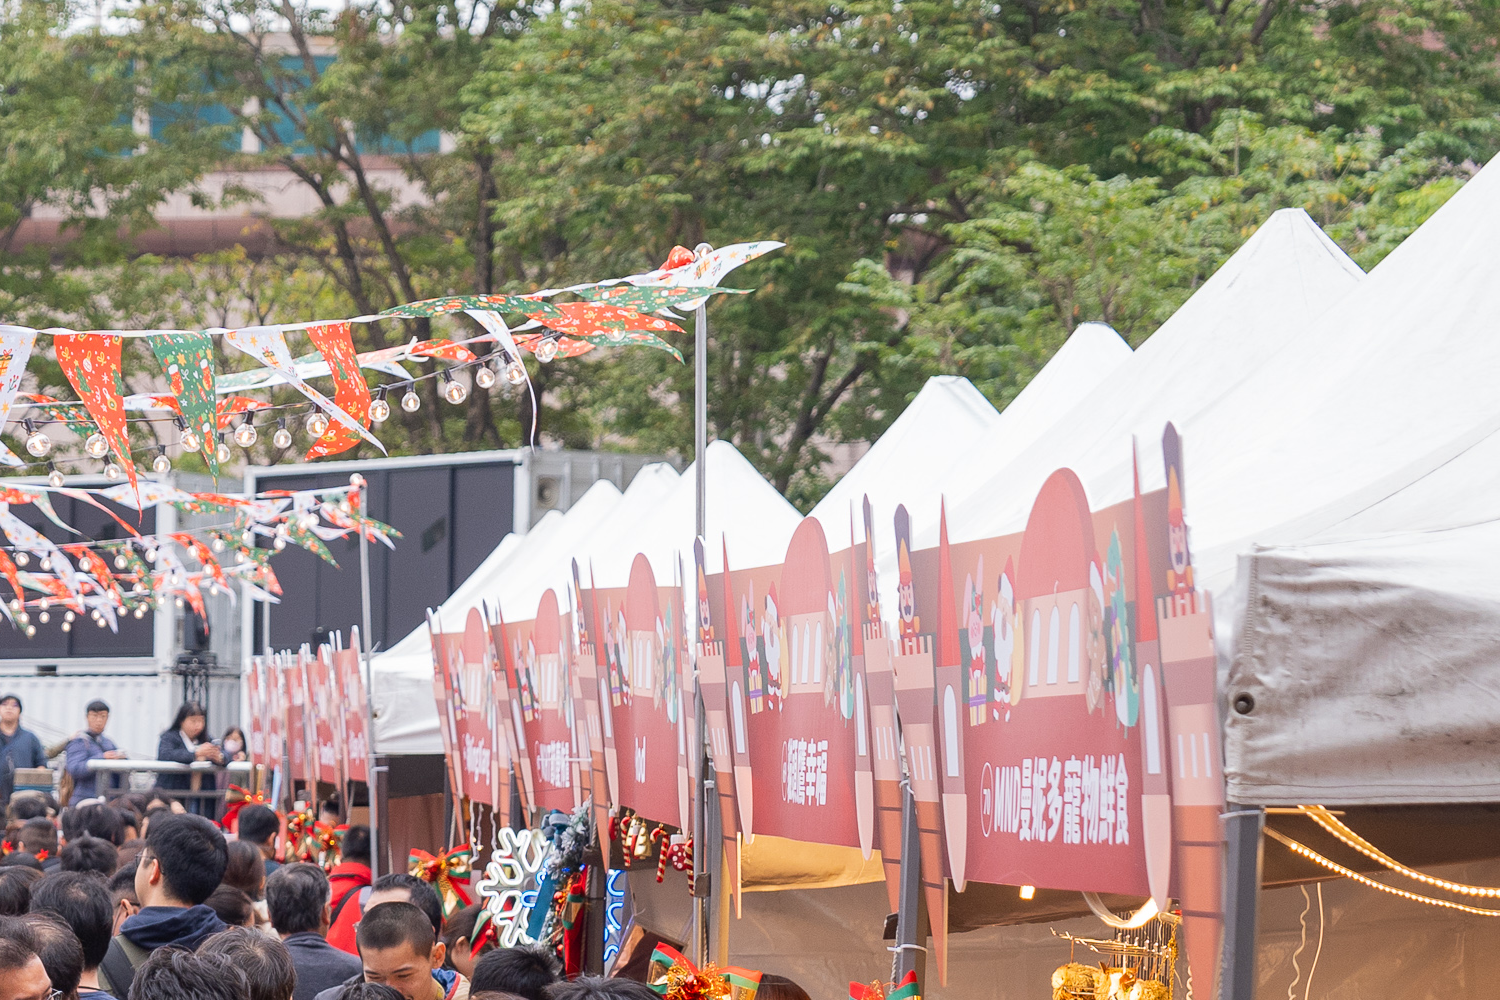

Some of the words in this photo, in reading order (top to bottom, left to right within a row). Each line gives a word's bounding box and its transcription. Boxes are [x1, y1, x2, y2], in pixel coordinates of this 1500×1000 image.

[994, 753, 1129, 845] MND曼妮多寵物鮮食
